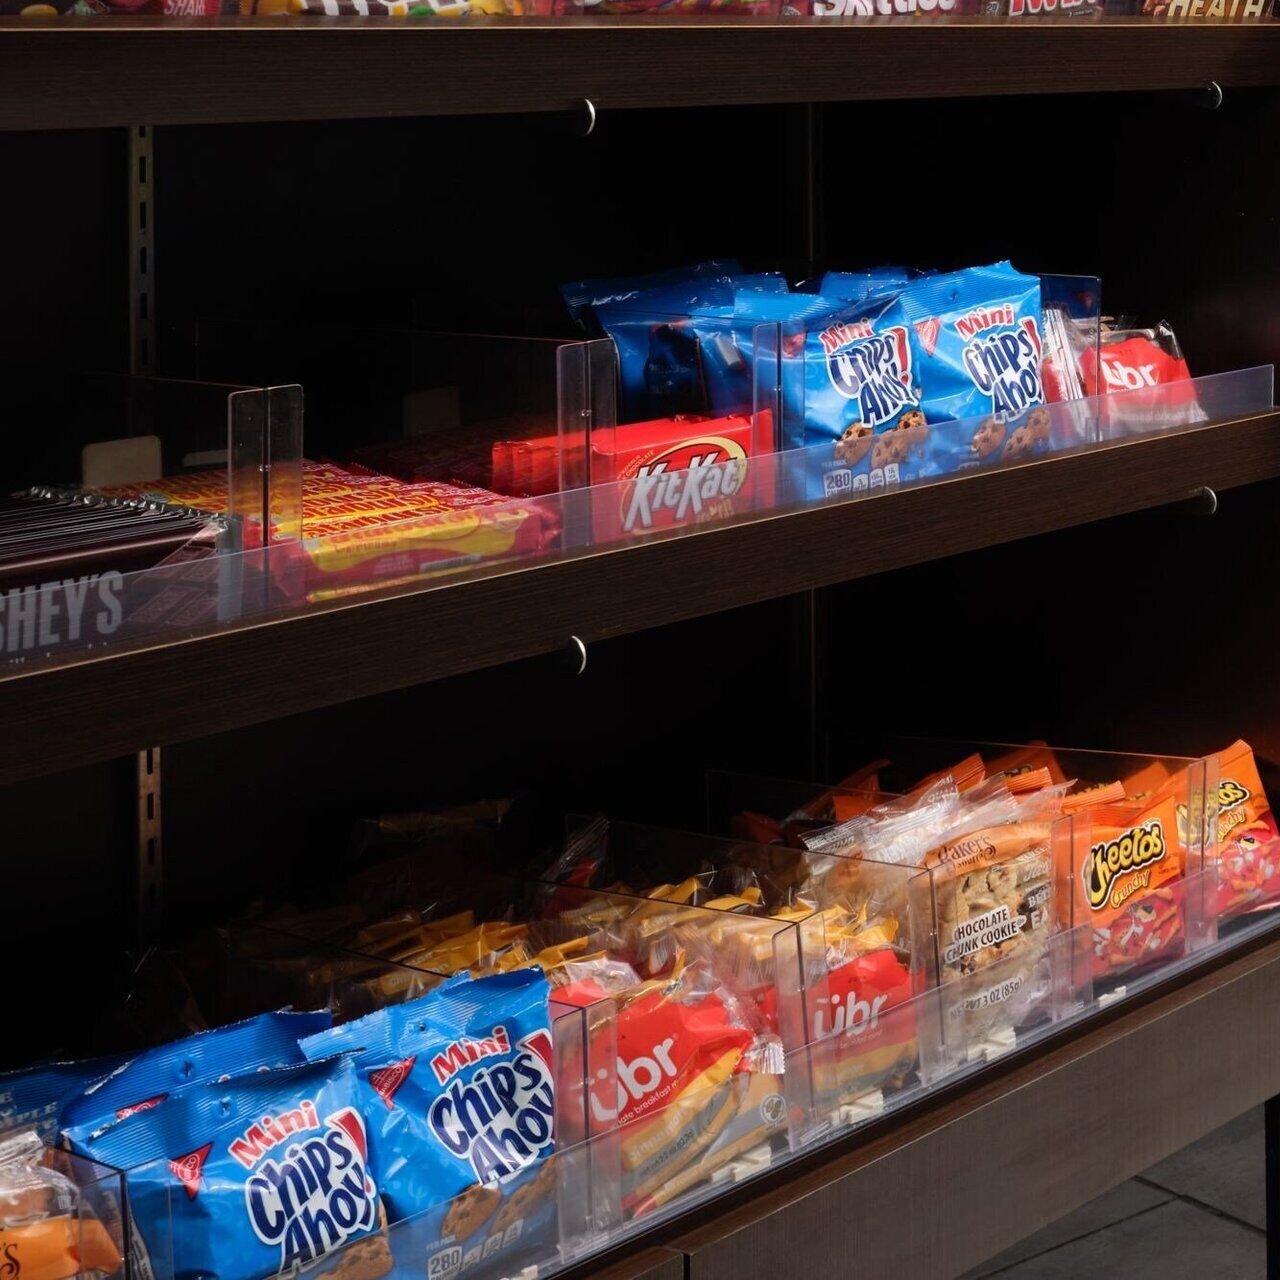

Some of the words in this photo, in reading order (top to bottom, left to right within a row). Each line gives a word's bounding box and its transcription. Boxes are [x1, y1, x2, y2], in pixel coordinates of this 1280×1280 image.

[820, 319, 873, 353] Mini
[955, 305, 1014, 337] Mini
[829, 334, 896, 395] Chips
[963, 329, 1034, 392] Chips
[826, 471, 850, 489] 280
[1083, 823, 1164, 908] Cheetos
[1110, 870, 1151, 908] Crunchy
[946, 937, 979, 964] CHUNK
[980, 921, 1018, 947] COOKIE
[955, 908, 1009, 941] CHOCOLATE
[982, 995, 989, 1007] 3
[989, 987, 1001, 1002] OZ
[431, 1026, 509, 1086] Mini
[432, 1053, 542, 1155] Chips
[633, 1088, 672, 1118] breakfast
[229, 1100, 318, 1169] Mini
[249, 1130, 351, 1241] Chips
[430, 1249, 461, 1276] 280
